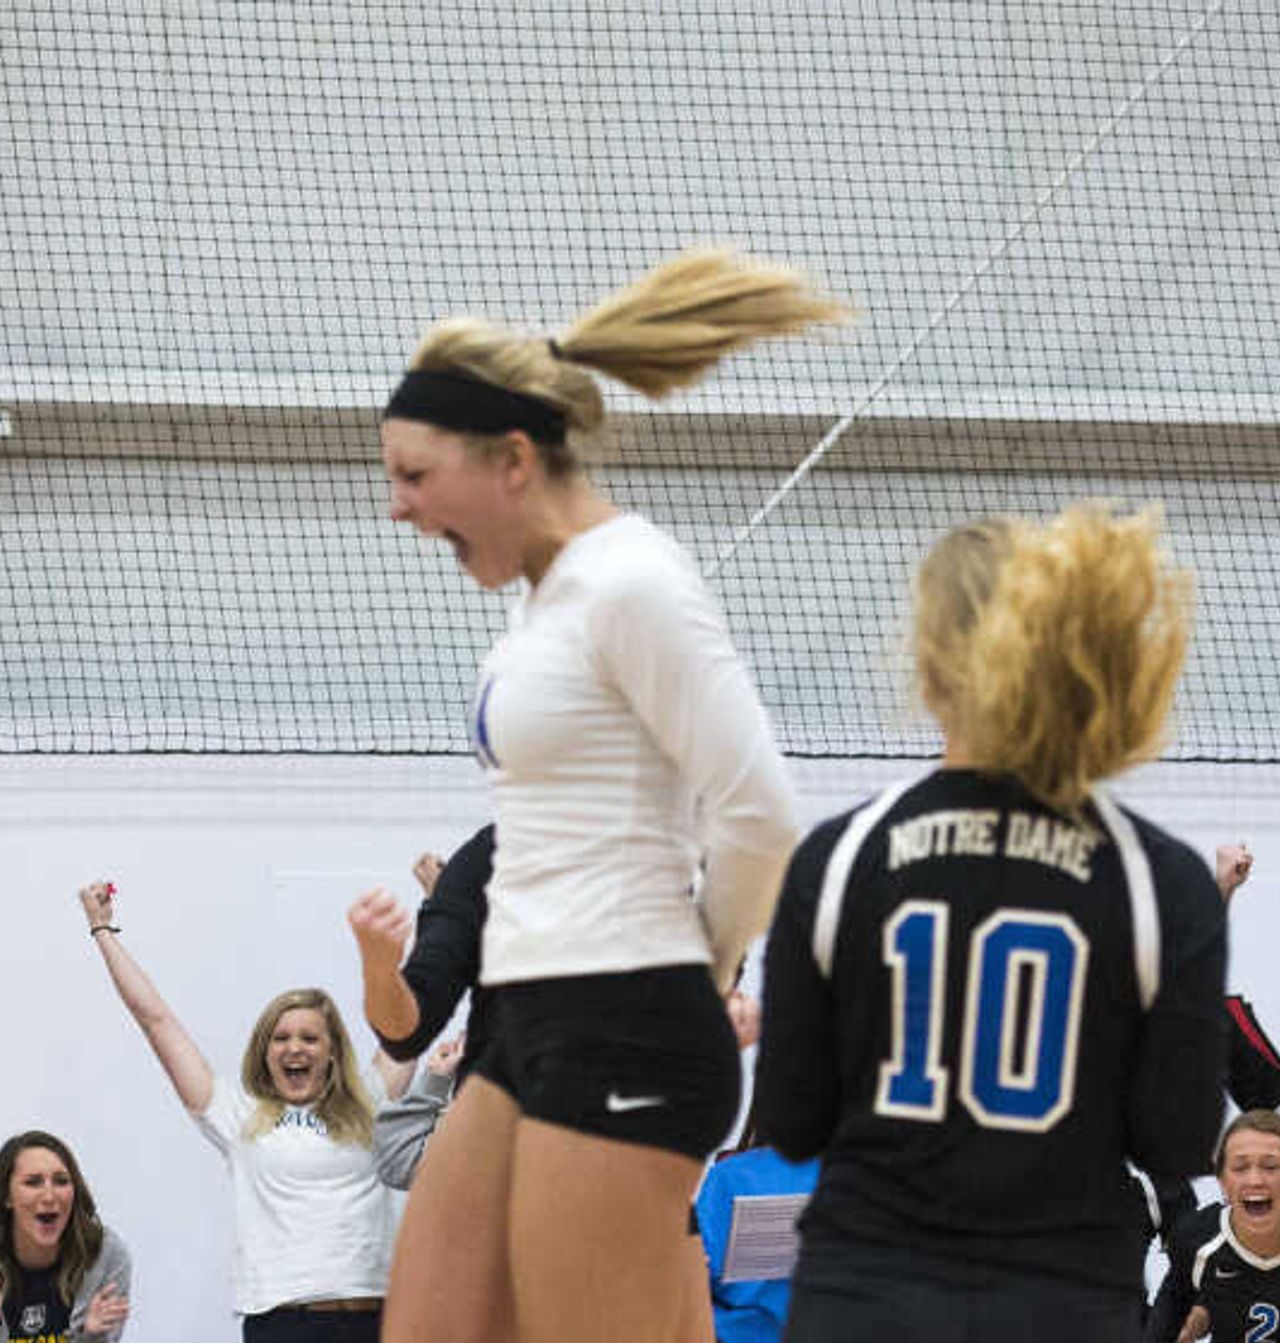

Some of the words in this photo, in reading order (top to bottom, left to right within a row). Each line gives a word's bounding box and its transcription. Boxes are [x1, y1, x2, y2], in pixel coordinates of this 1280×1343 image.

[888, 809, 1001, 871] NOTRE
[1005, 811, 1096, 884] DAME
[873, 899, 1091, 1133] 10
